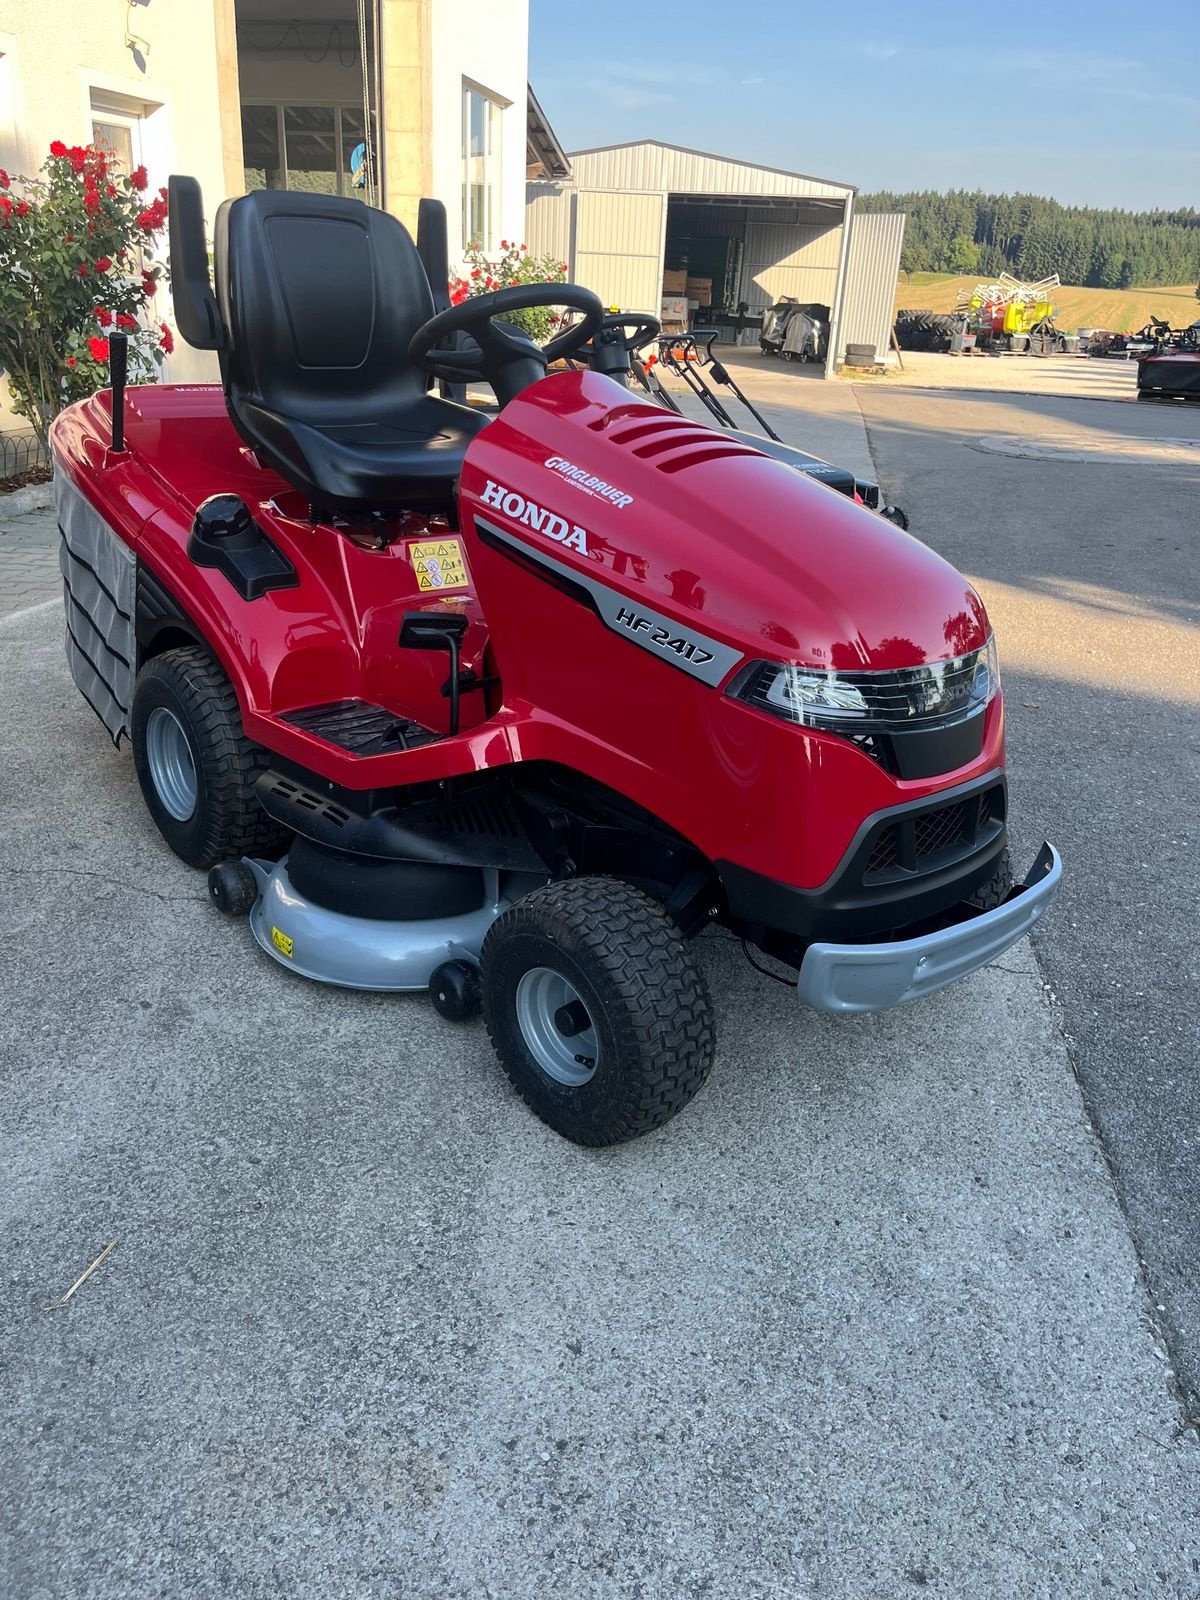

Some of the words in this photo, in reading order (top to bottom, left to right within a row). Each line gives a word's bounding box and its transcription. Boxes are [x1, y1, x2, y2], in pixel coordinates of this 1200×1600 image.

[544, 456, 634, 509] GANGLBAUER
[480, 480, 589, 556] HONDA
[615, 607, 654, 633] HF
[650, 627, 715, 666] 2417
